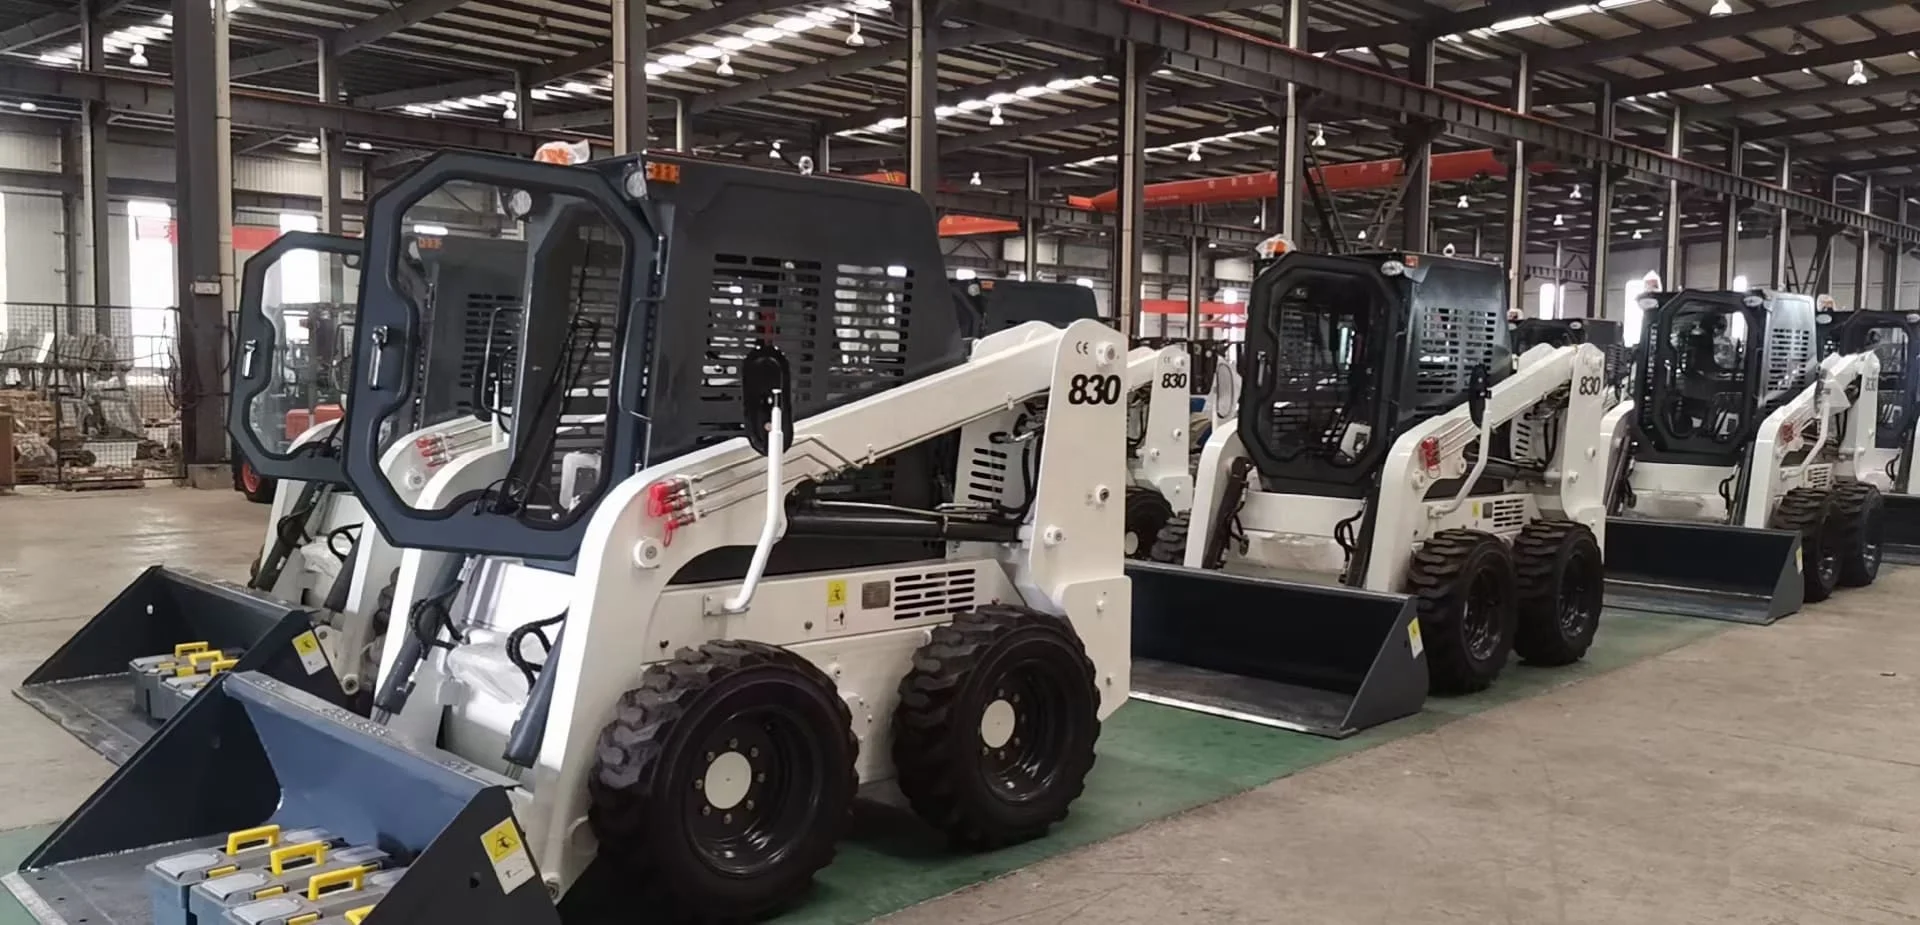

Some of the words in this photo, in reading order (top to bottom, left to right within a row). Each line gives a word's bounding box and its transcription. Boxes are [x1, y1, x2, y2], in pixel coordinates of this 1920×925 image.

[1068, 374, 1121, 405] 830
[1162, 373, 1187, 388] 830
[1579, 376, 1600, 395] 830
